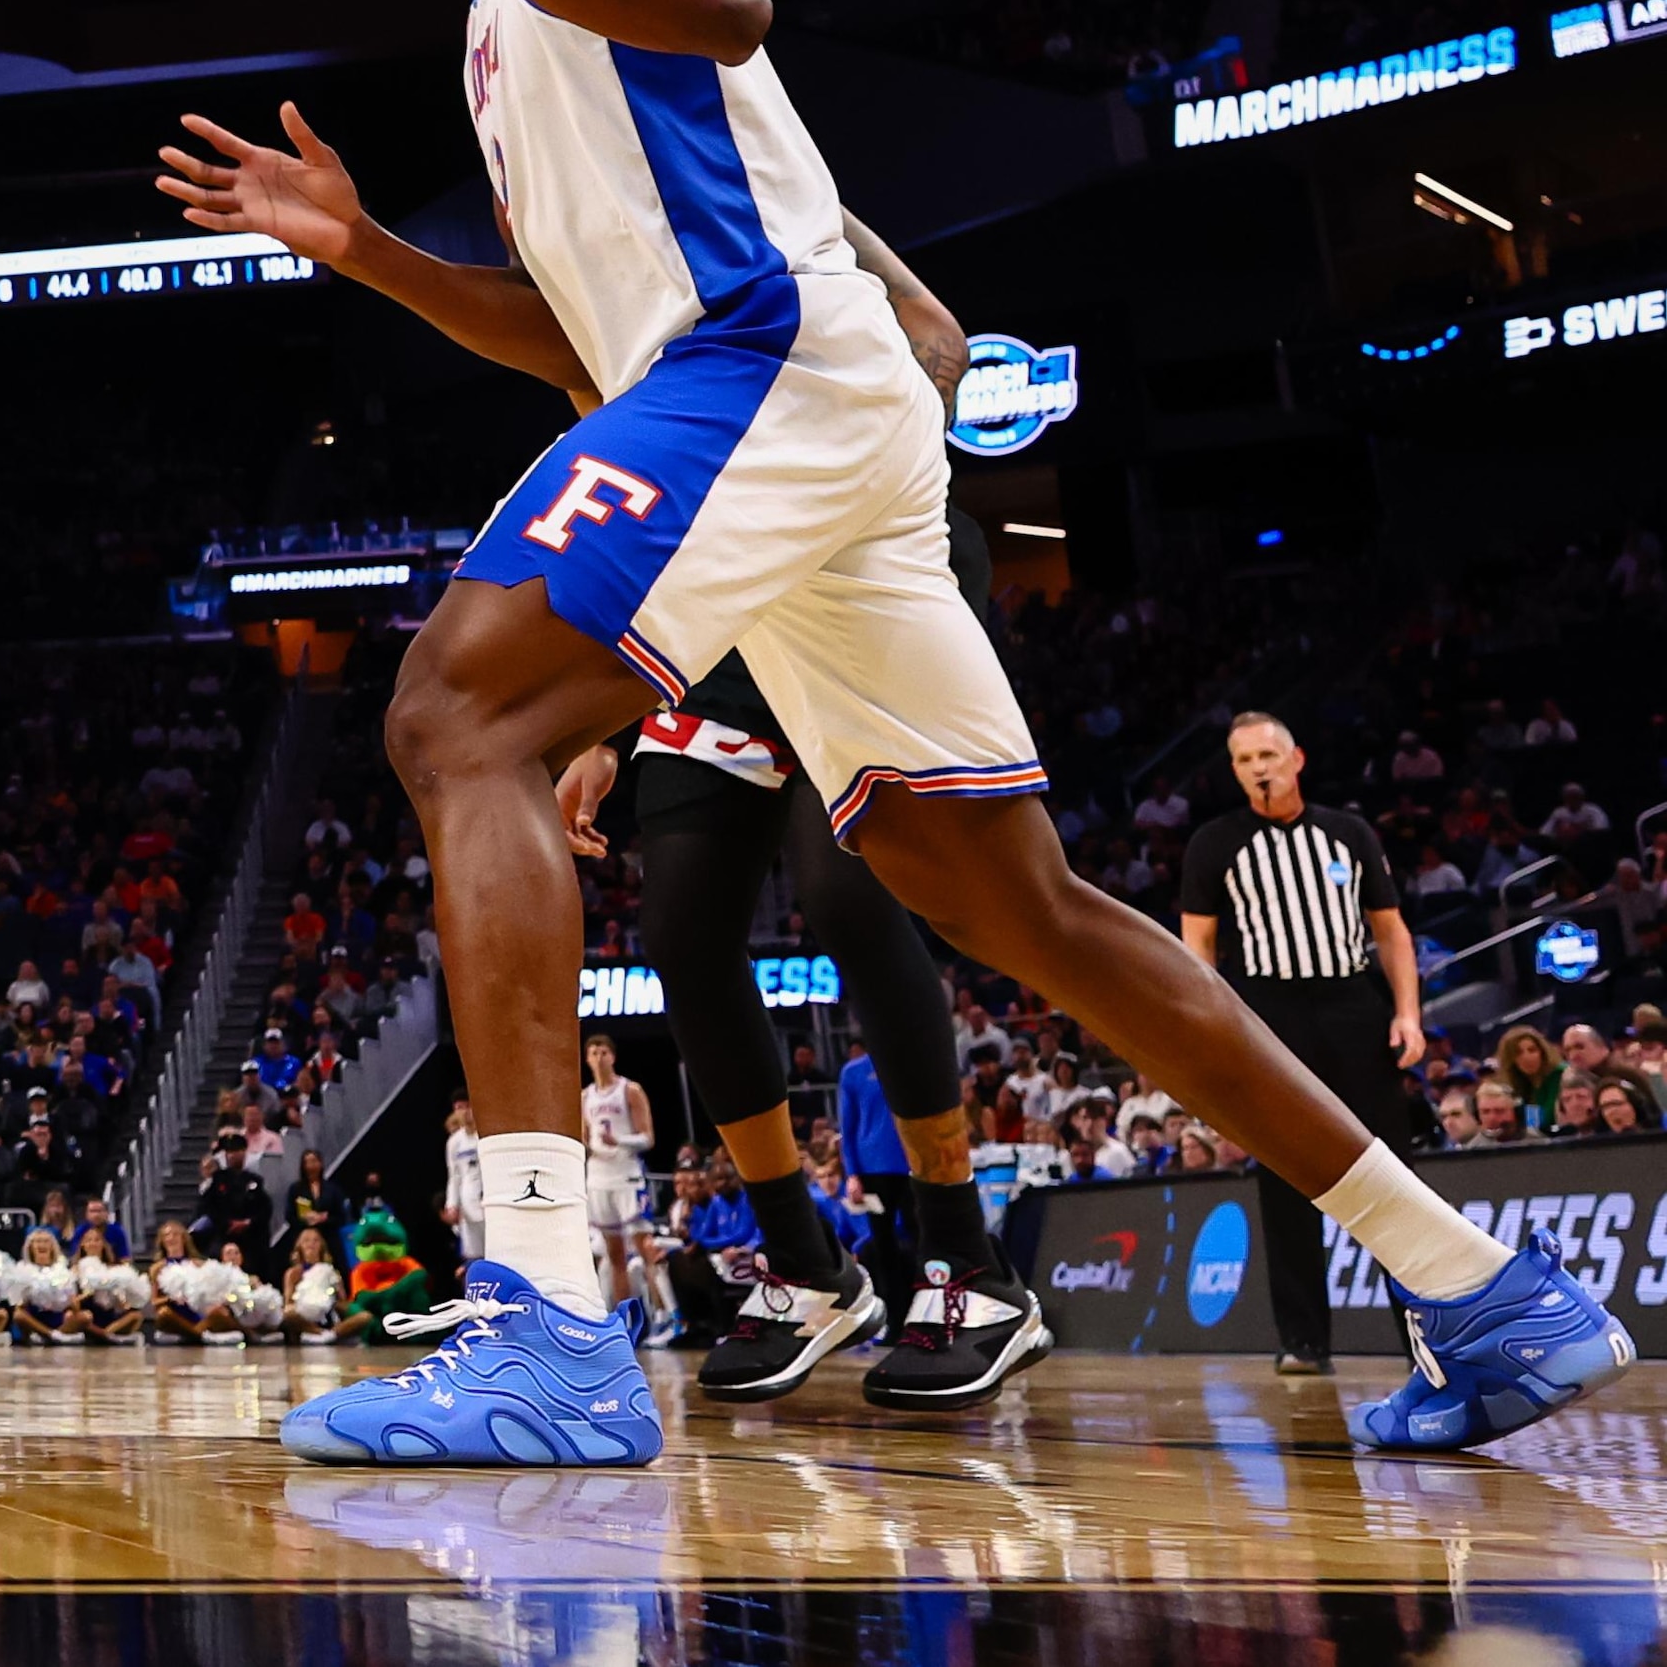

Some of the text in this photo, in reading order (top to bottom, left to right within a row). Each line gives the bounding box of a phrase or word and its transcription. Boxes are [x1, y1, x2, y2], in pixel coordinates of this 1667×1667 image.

[1174, 26, 1516, 148] MARCHMADNESS
[1563, 289, 1667, 346] SWE
[522, 454, 663, 554] F
